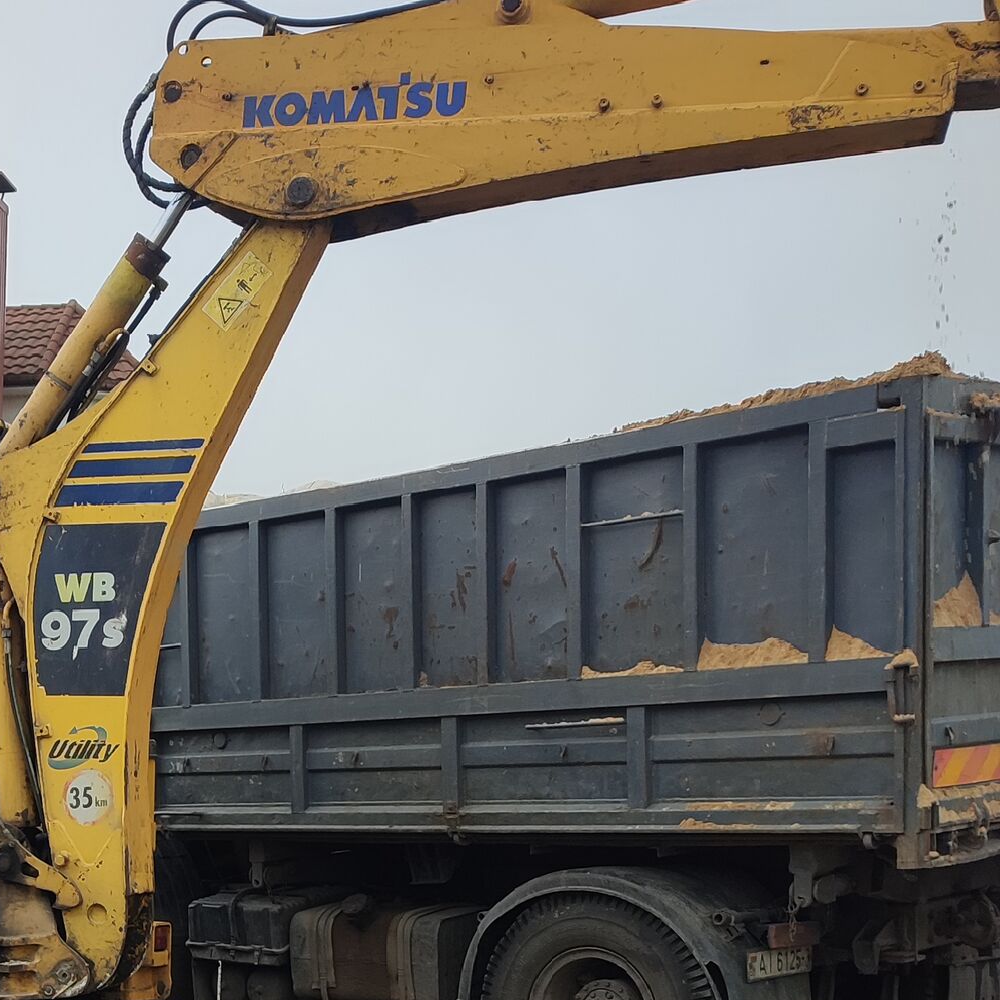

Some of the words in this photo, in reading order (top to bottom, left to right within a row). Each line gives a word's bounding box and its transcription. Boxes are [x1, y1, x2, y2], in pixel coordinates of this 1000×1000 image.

[242, 72, 468, 128] KOMATSU
[54, 572, 116, 603] WB
[47, 739, 120, 763] Utility
[69, 786, 93, 810] 35
[95, 796, 108, 808] km
